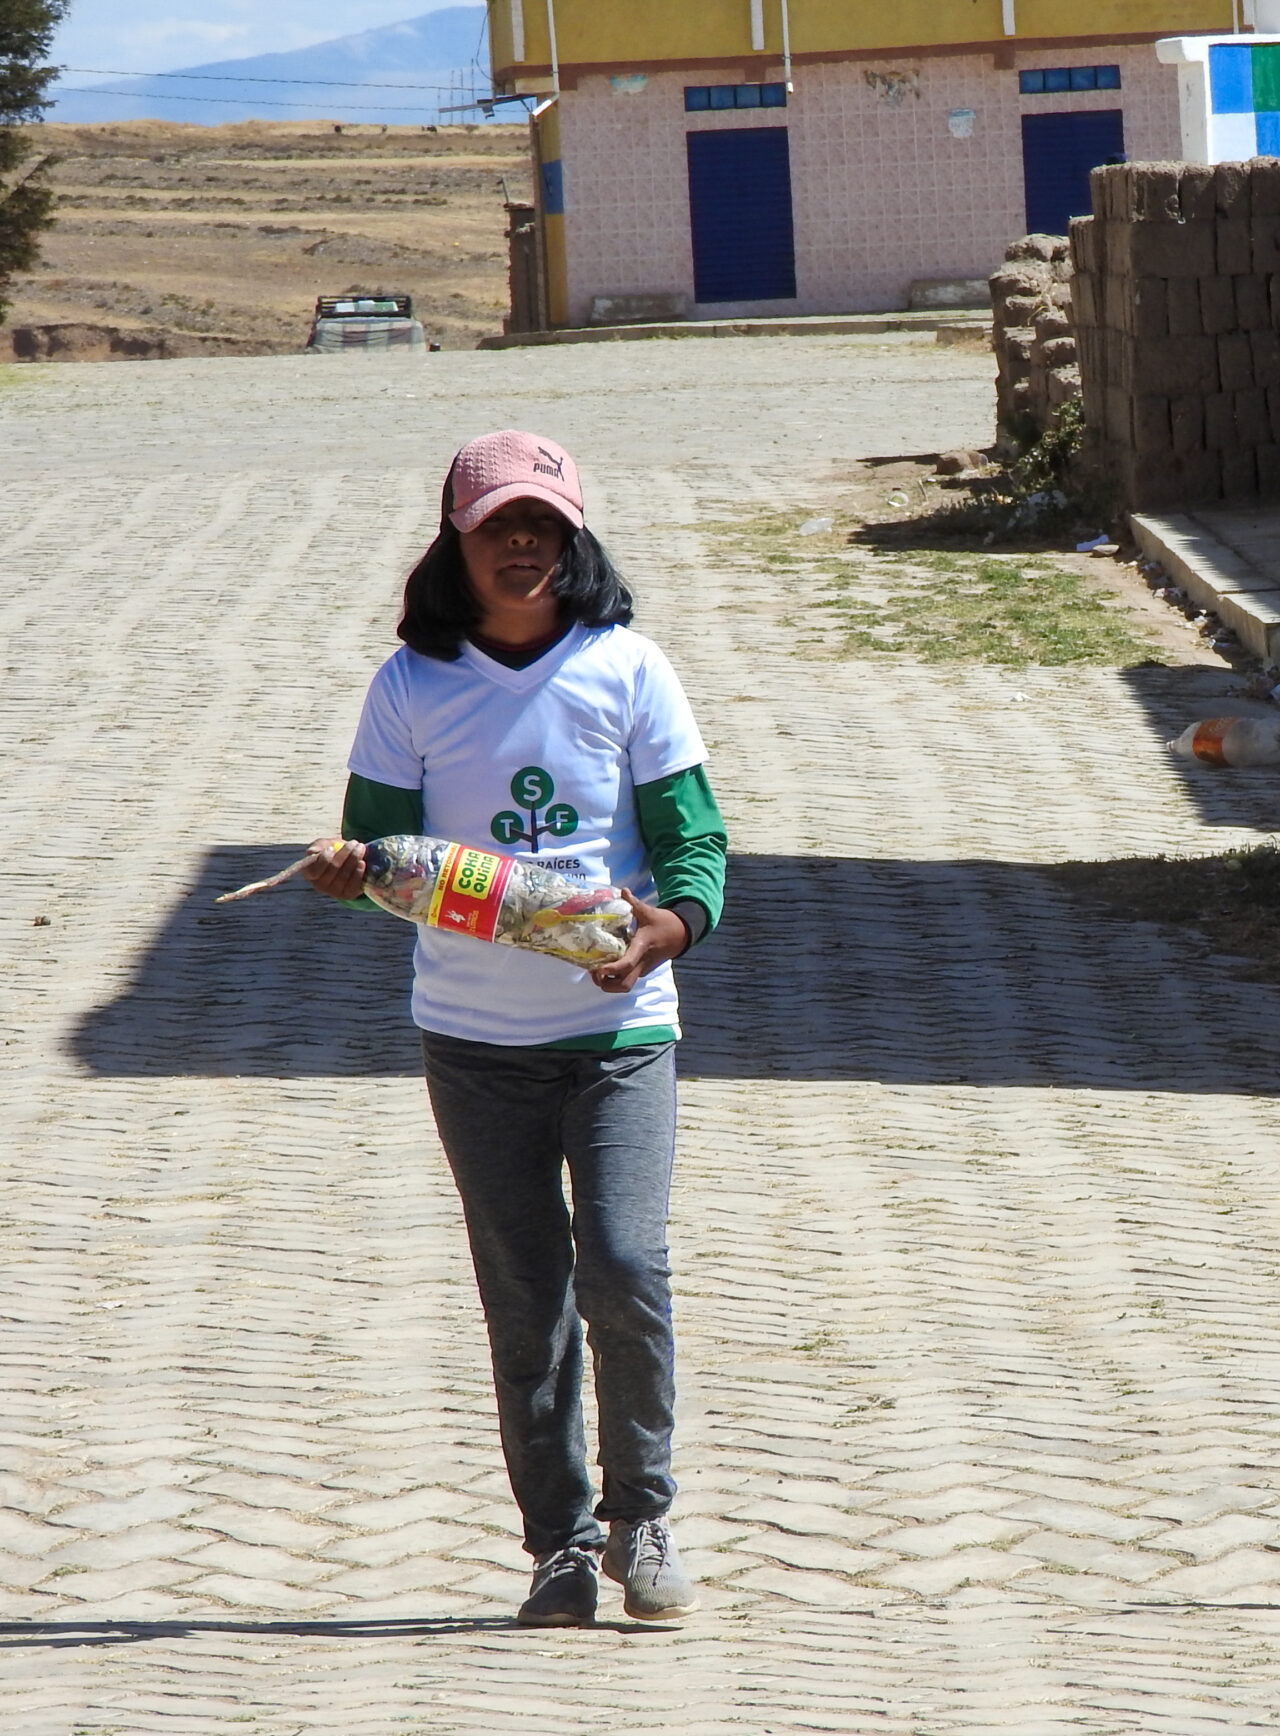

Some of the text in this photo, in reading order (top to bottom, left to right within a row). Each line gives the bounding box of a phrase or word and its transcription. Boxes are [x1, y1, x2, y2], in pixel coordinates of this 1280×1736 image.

[533, 463, 559, 478] PUMA
[523, 775, 543, 801] S
[500, 819, 514, 838] T
[556, 811, 569, 830] F
[458, 852, 480, 889] COKA
